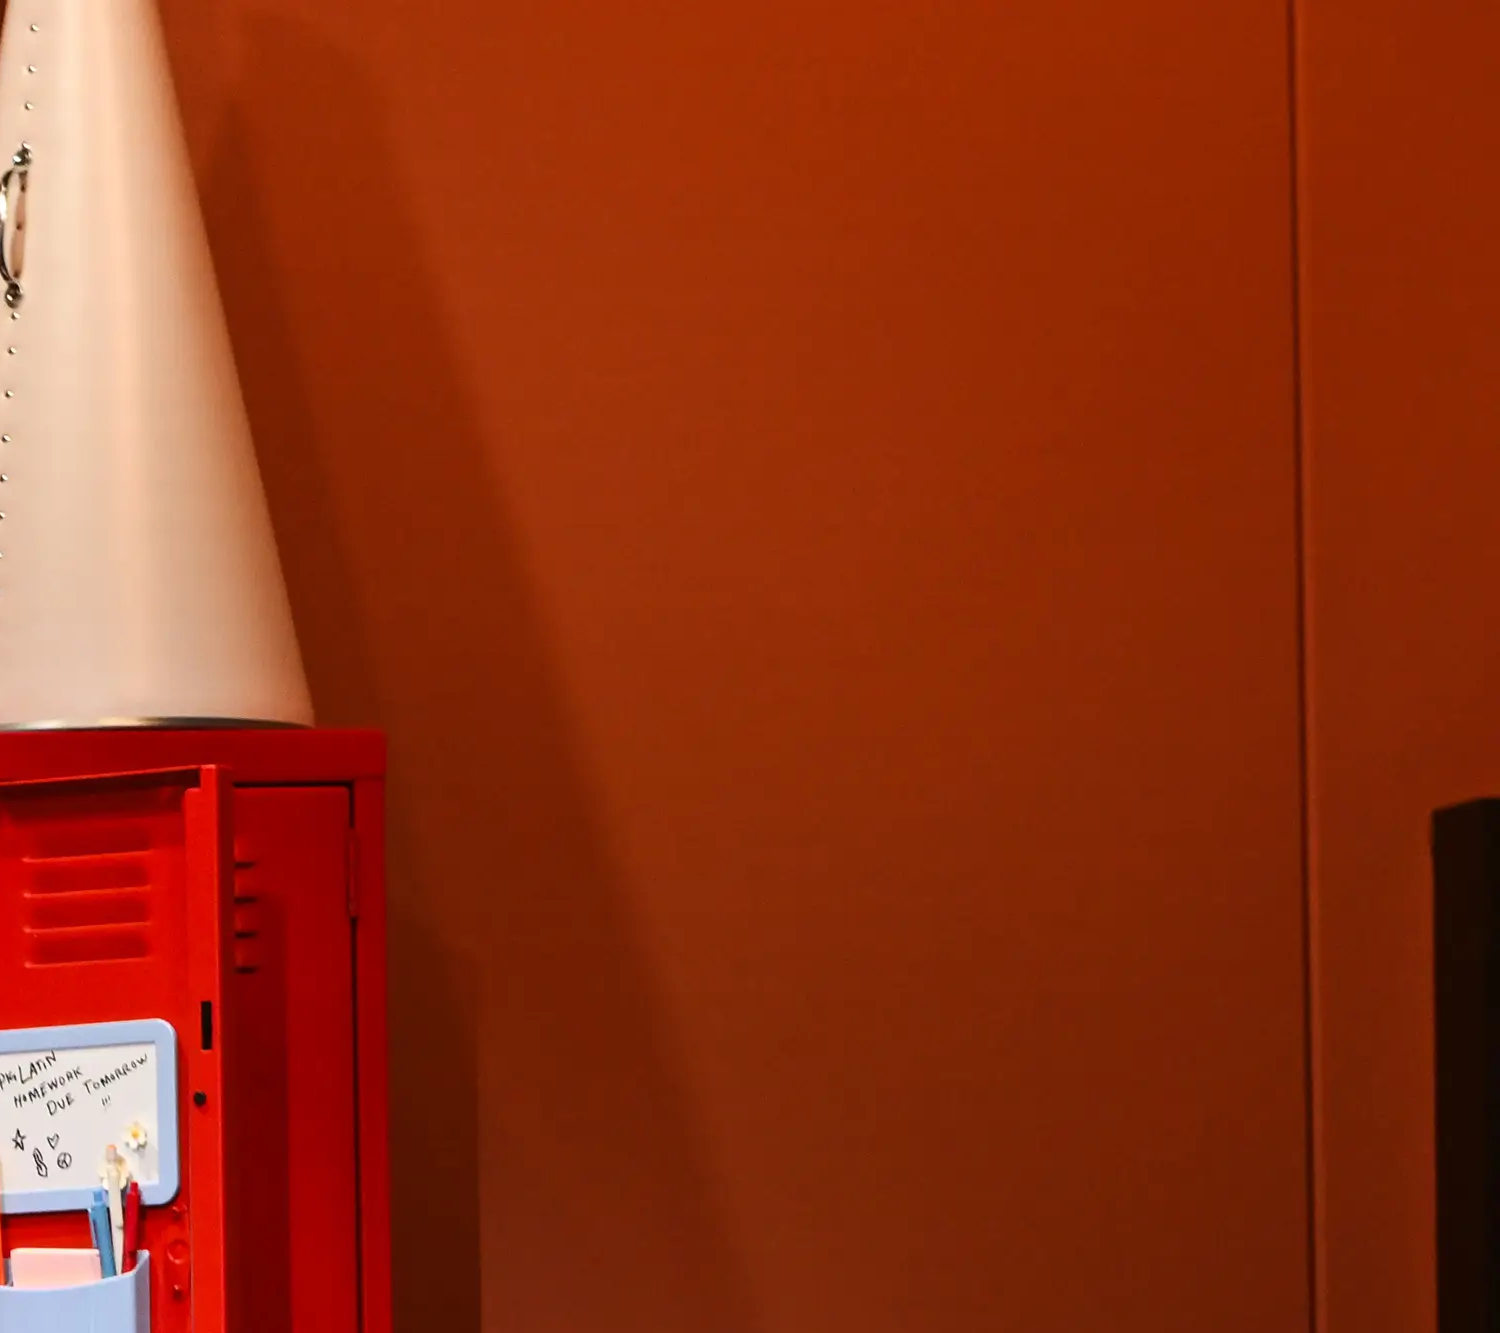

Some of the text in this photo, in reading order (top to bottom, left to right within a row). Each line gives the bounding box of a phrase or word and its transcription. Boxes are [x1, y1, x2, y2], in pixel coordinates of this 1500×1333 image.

[13, 1066, 84, 1109] HOMEWORK
[46, 1053, 148, 1116] DUE TOMORROW
